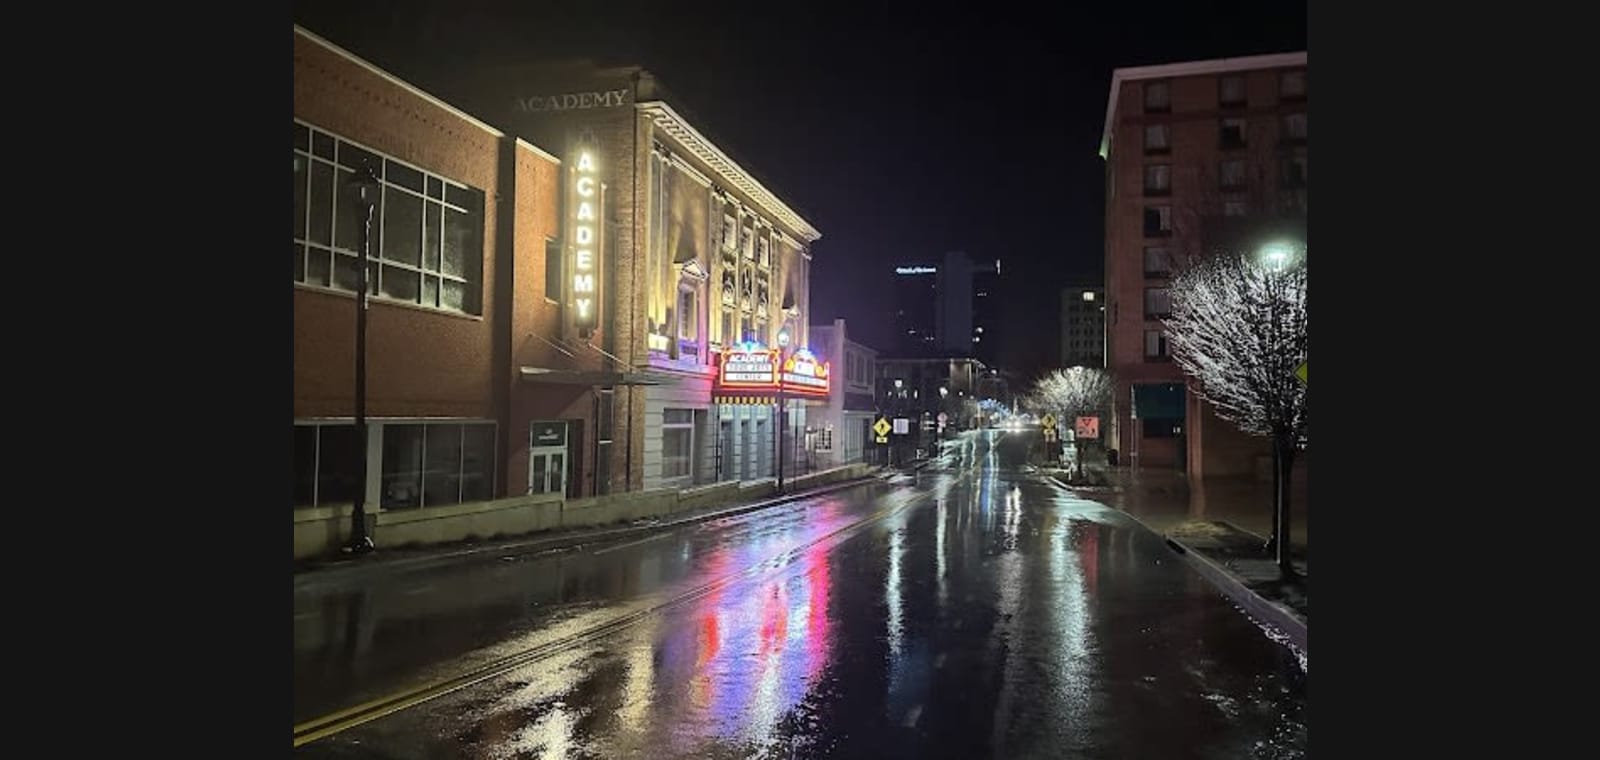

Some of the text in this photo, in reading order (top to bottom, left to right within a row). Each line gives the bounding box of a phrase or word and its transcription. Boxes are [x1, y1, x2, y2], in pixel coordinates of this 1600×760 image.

[516, 89, 627, 112] ACADEMY
[574, 152, 594, 318] ACADEMY
[729, 354, 769, 364] ACADEMY
